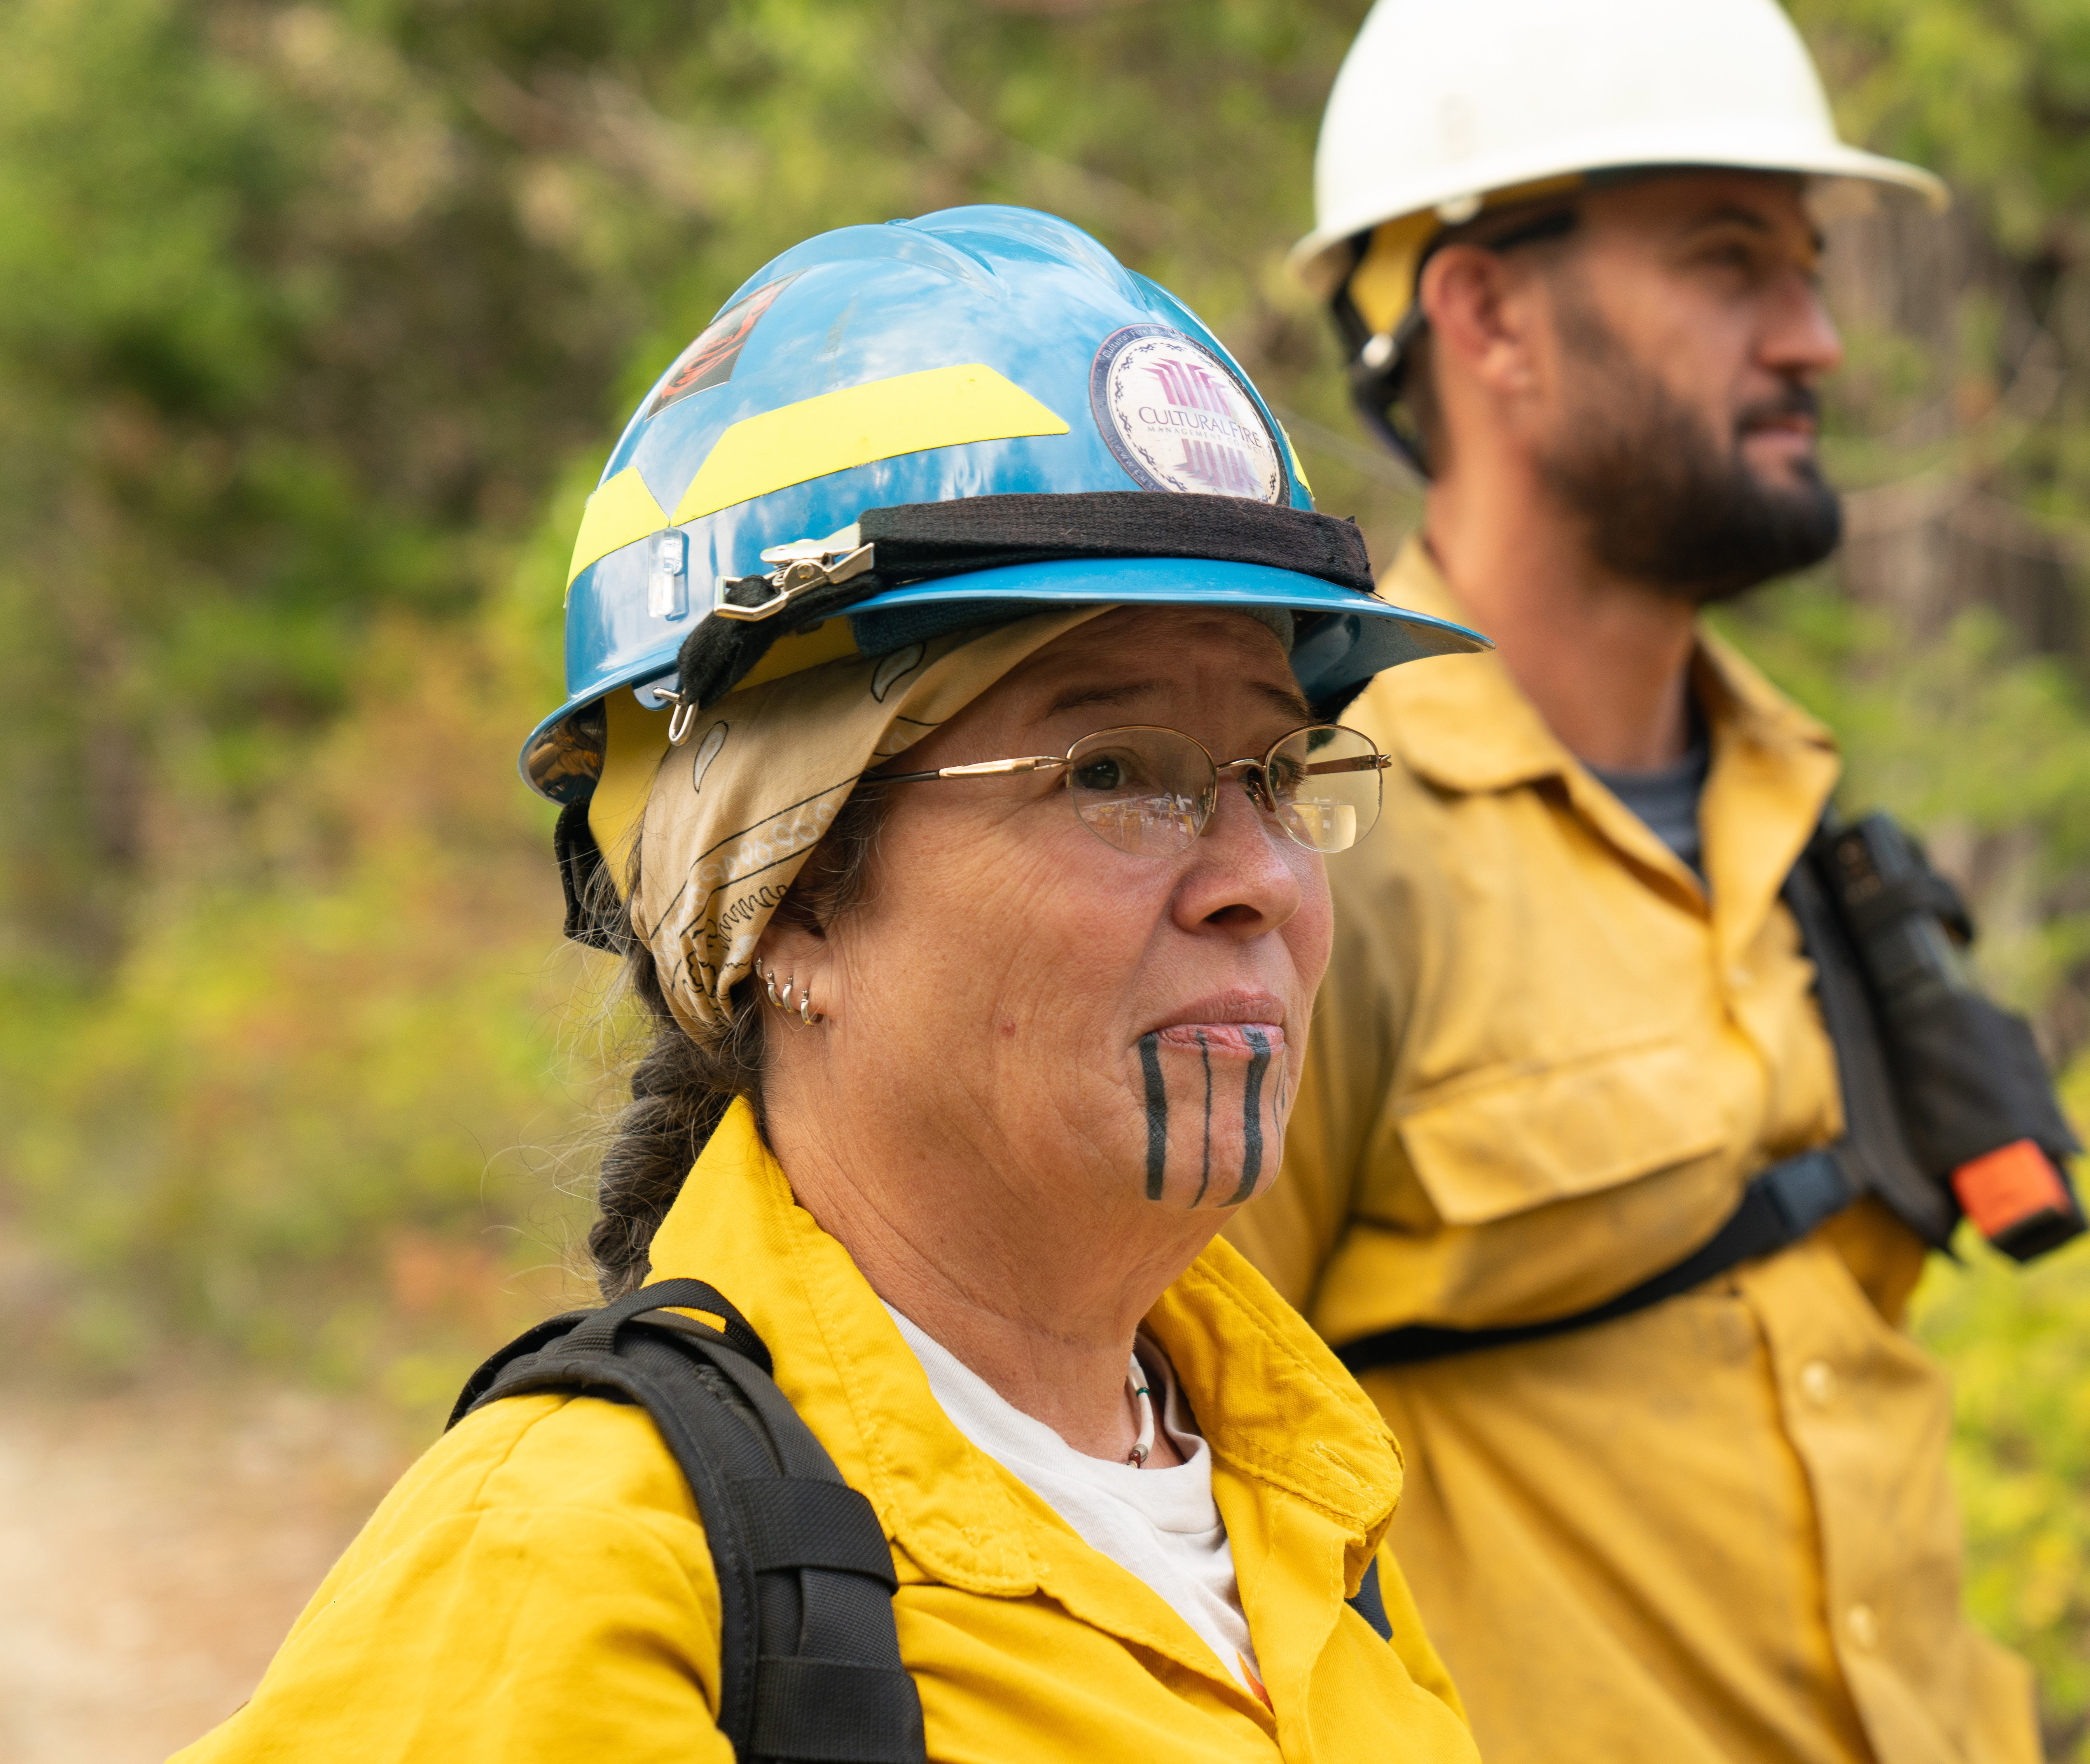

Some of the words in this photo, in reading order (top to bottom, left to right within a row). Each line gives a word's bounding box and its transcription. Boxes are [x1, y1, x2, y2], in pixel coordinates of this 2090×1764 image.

[1103, 333, 1130, 358] Cultural
[1129, 329, 1148, 339] Fire
[1213, 356, 1246, 390] Council
[1139, 407, 1230, 435] CULTURAL
[1228, 420, 1262, 448] FIRE
[1148, 426, 1221, 441] MANAGEMENT
[1227, 438, 1266, 457] COUNCIL
